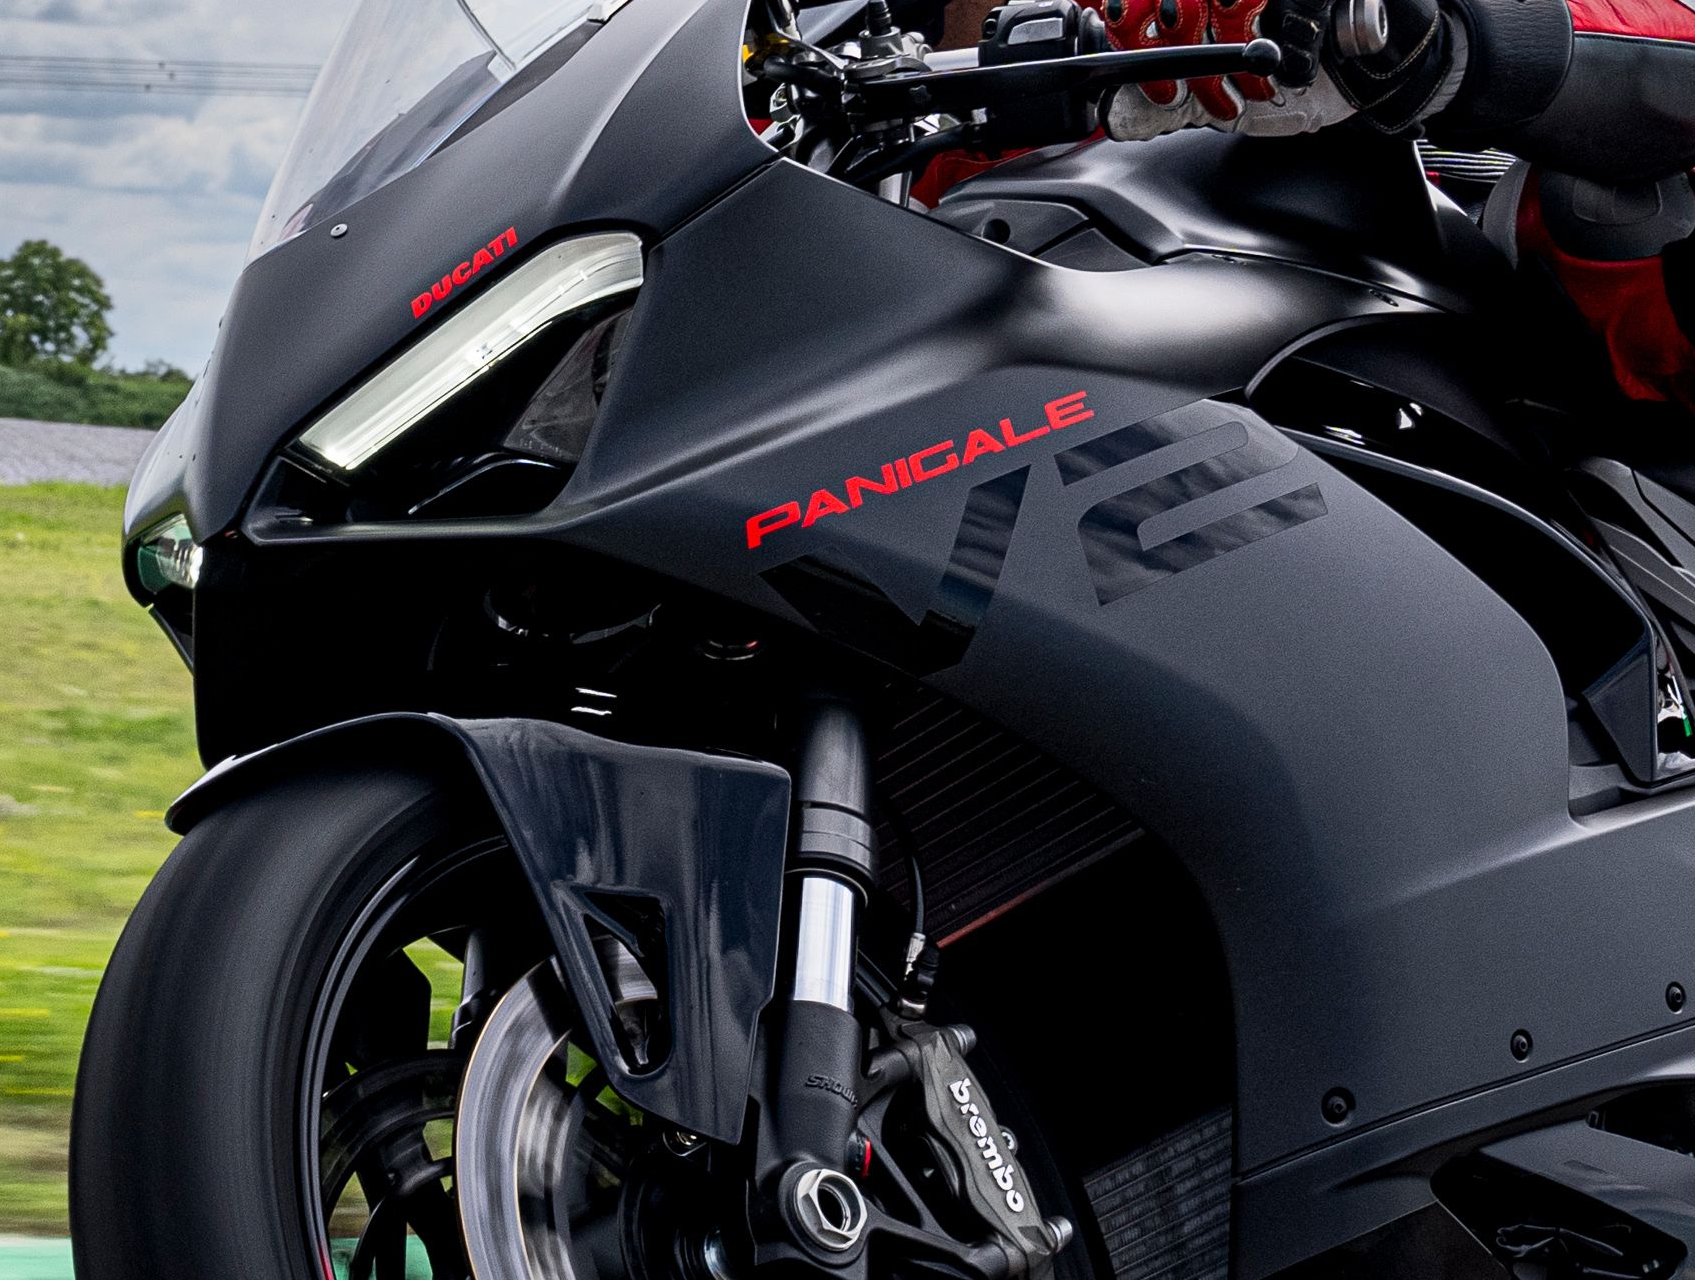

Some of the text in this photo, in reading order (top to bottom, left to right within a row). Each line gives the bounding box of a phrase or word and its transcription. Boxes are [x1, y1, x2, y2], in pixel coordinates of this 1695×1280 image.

[410, 225, 518, 319] DUCATI
[745, 390, 1095, 549] PANIGALE
[949, 1077, 1025, 1213] brembo
